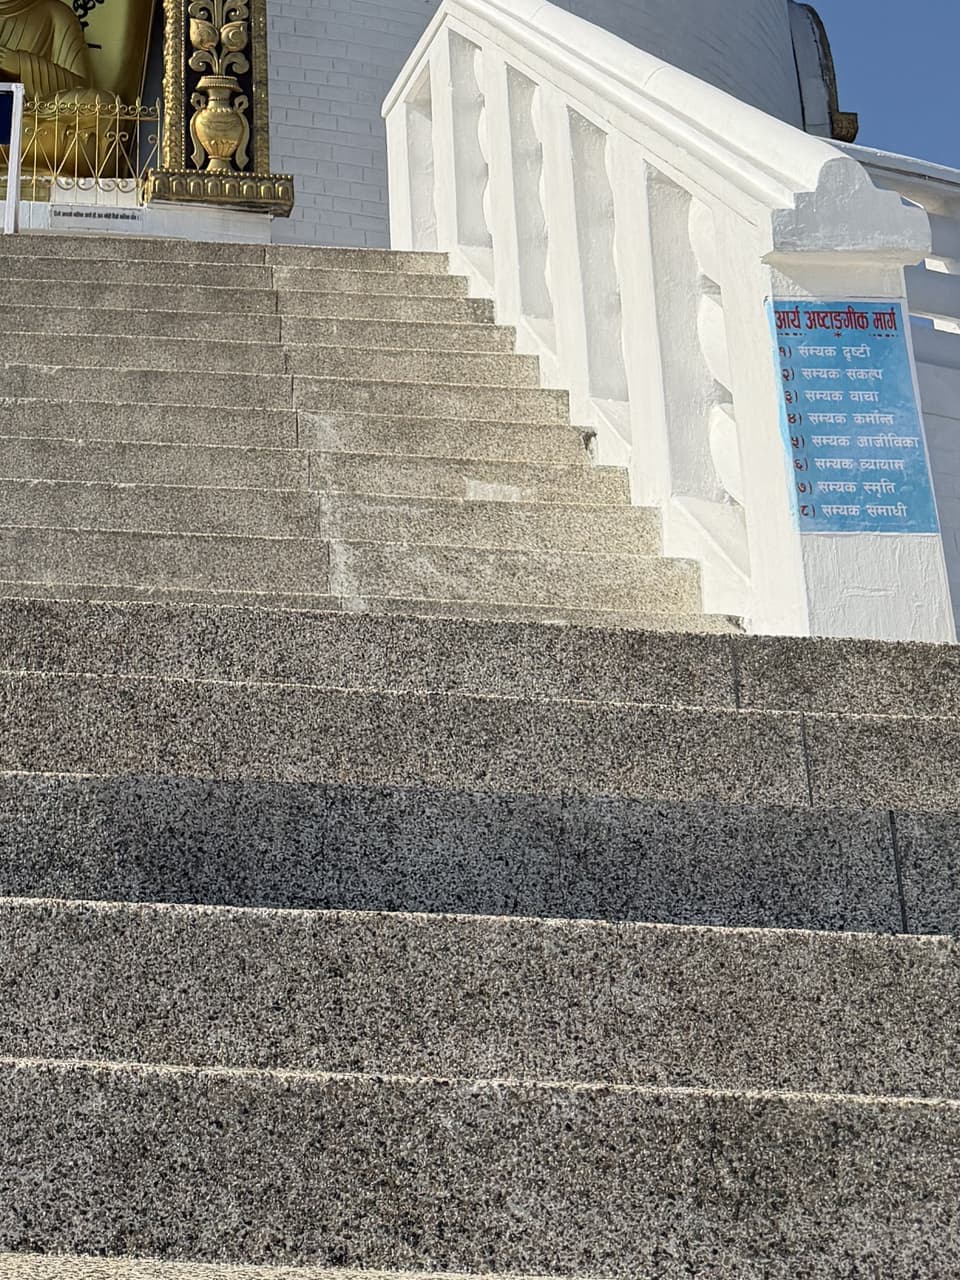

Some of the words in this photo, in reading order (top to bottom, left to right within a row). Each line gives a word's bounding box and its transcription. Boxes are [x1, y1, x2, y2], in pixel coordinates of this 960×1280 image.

[775, 306, 801, 329] आर्य
[872, 307, 897, 331] मार्ग
[798, 345, 836, 358] सम्यक
[801, 368, 840, 381] सम्यक
[804, 389, 843, 402] सम्यक
[849, 389, 879, 403] वाचा
[808, 412, 847, 425] सम्यक
[811, 435, 851, 448] सम्यक
[856, 433, 920, 448] आजीविका
[814, 457, 854, 471] सम्यक
[817, 481, 857, 494] सम्यक
[821, 505, 860, 518] सम्यक
